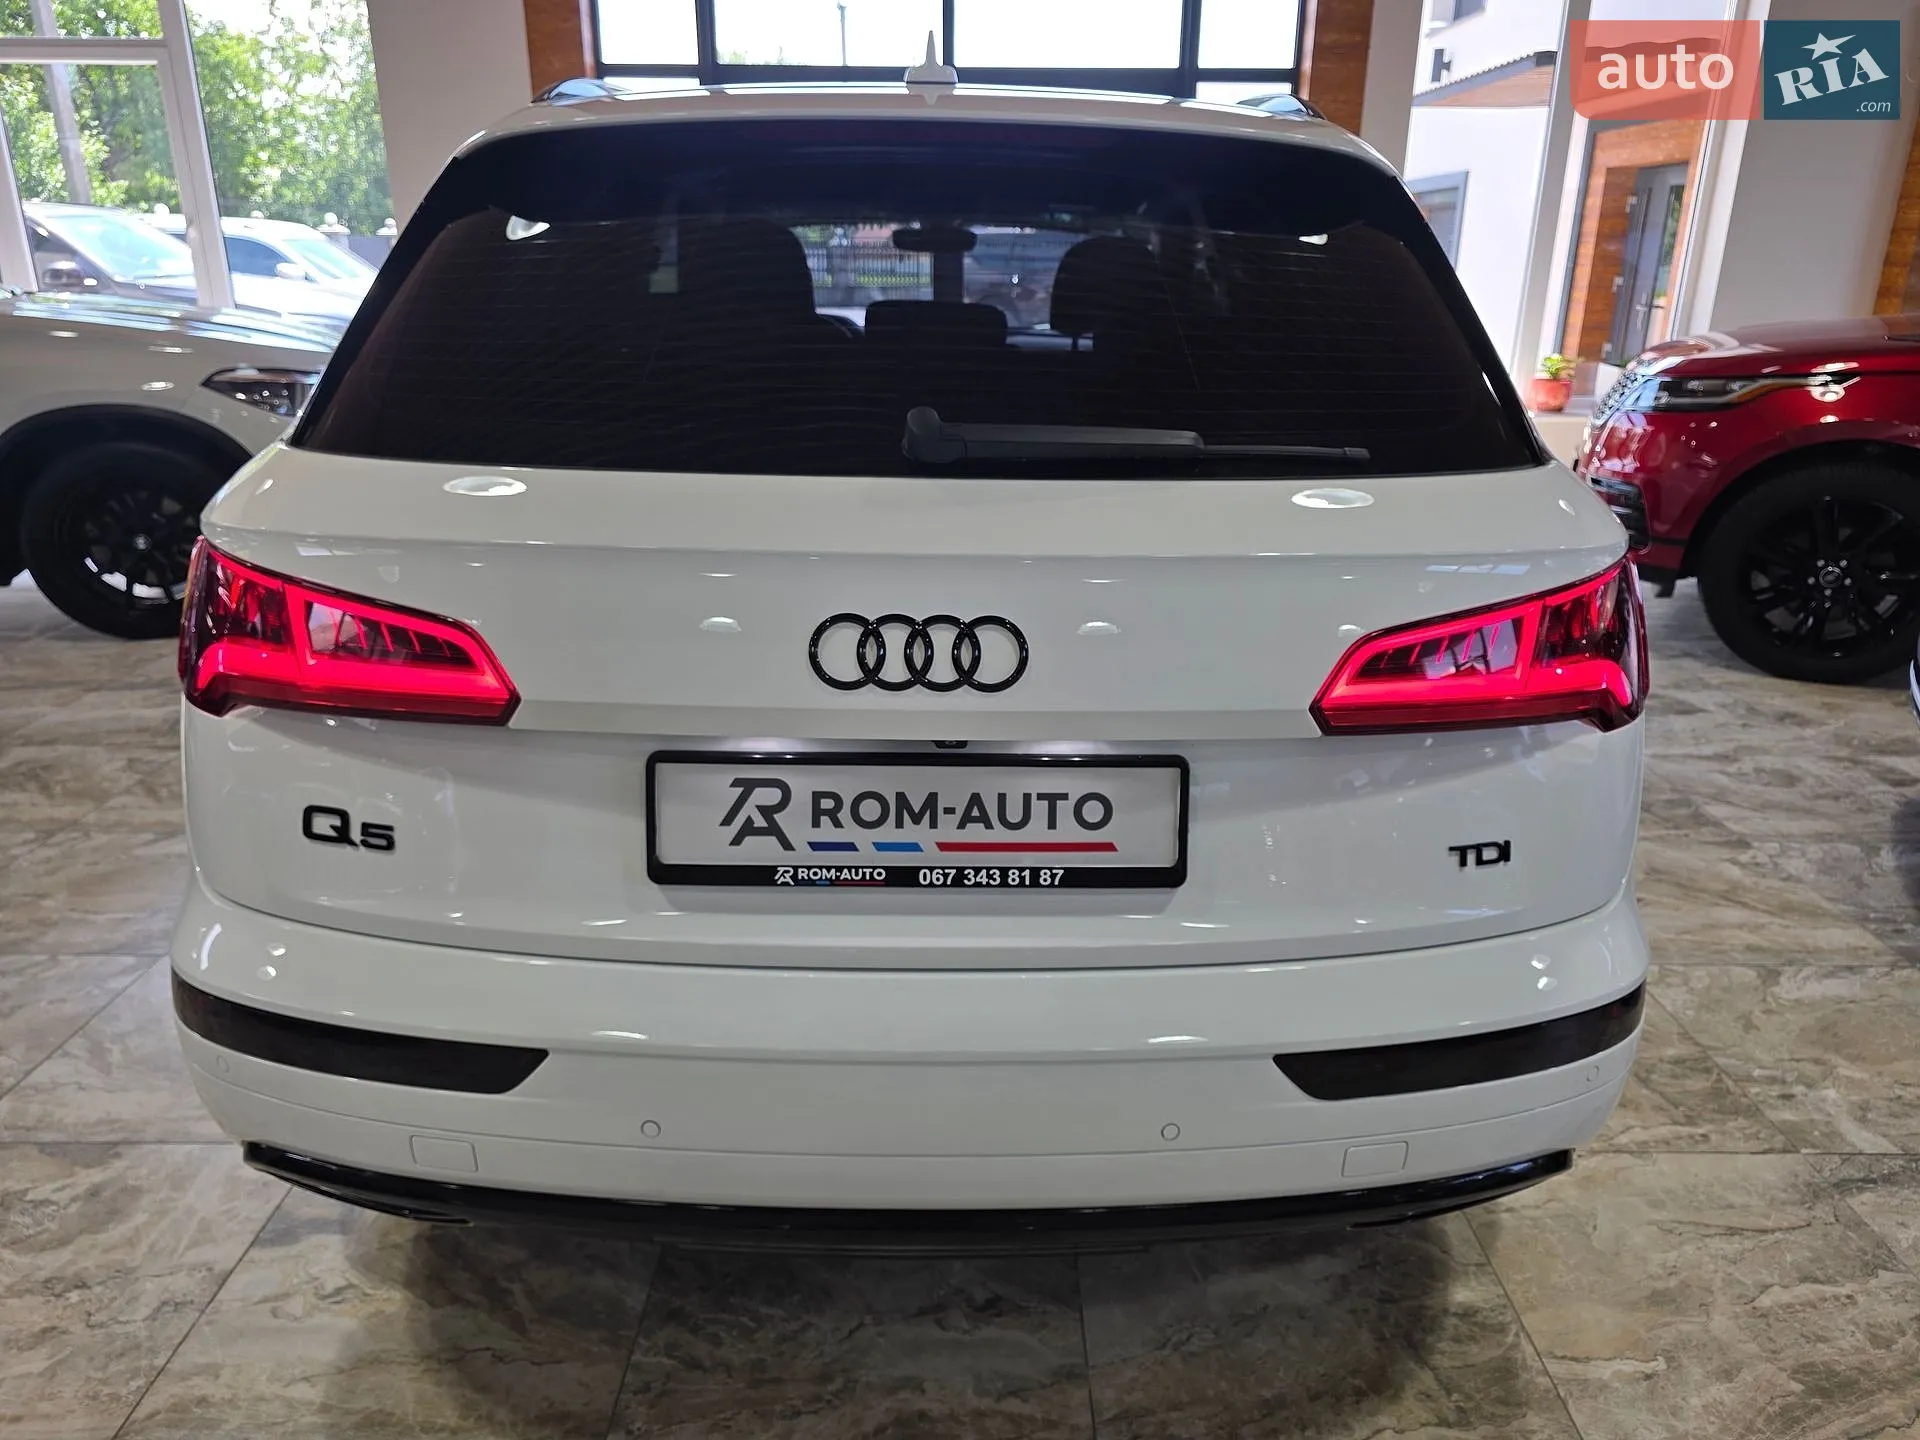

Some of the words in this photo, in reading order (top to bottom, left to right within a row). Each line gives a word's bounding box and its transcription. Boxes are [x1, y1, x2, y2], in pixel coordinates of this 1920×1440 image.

[302, 804, 395, 851] Q5
[811, 790, 1114, 831] ROM-AUTO
[1448, 839, 1511, 867] TDI
[798, 868, 886, 881] ROM-AUTO
[918, 868, 956, 885] 067
[963, 869, 1000, 885] 343
[1007, 869, 1030, 885] 81
[1039, 869, 1064, 885] 87
